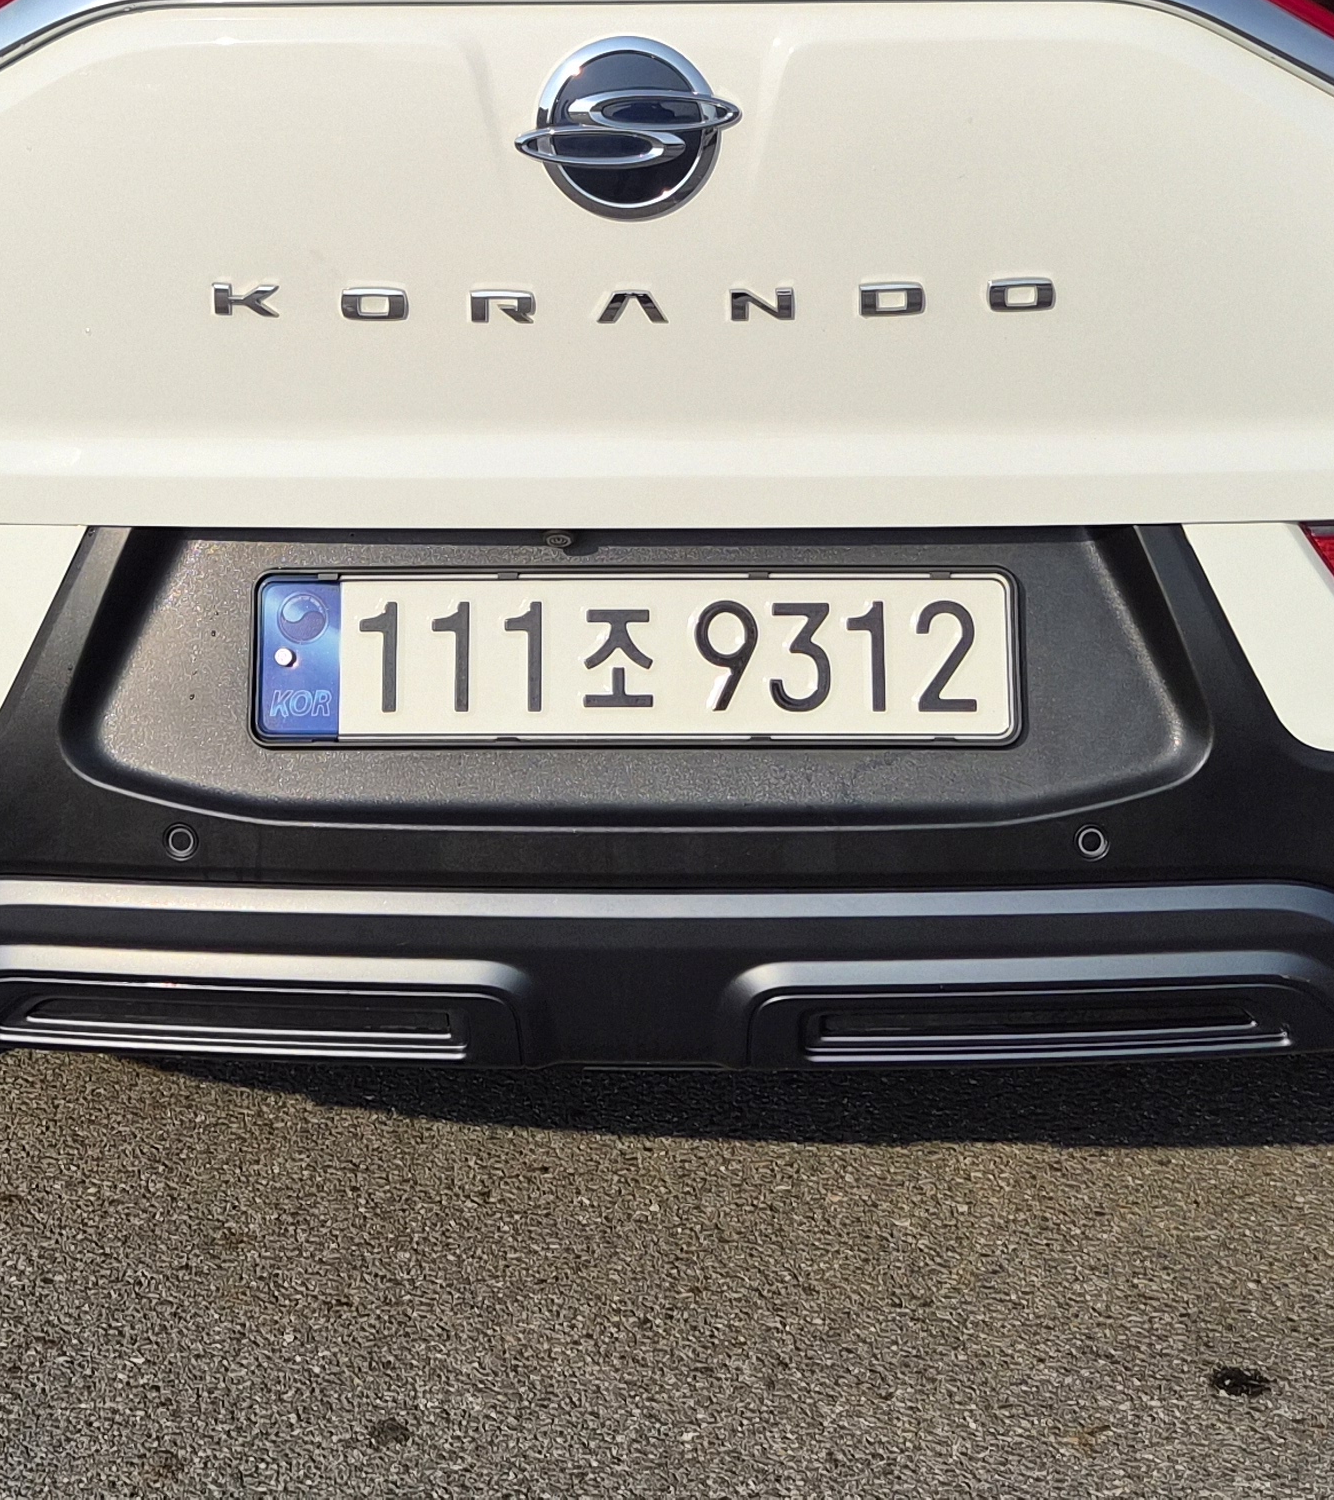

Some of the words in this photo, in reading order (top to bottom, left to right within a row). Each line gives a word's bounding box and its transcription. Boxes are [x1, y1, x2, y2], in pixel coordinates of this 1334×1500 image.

[212, 277, 1057, 324] KORANDO
[358, 600, 655, 713] 111조
[694, 600, 978, 713] 9312
[269, 689, 333, 717] KOR
